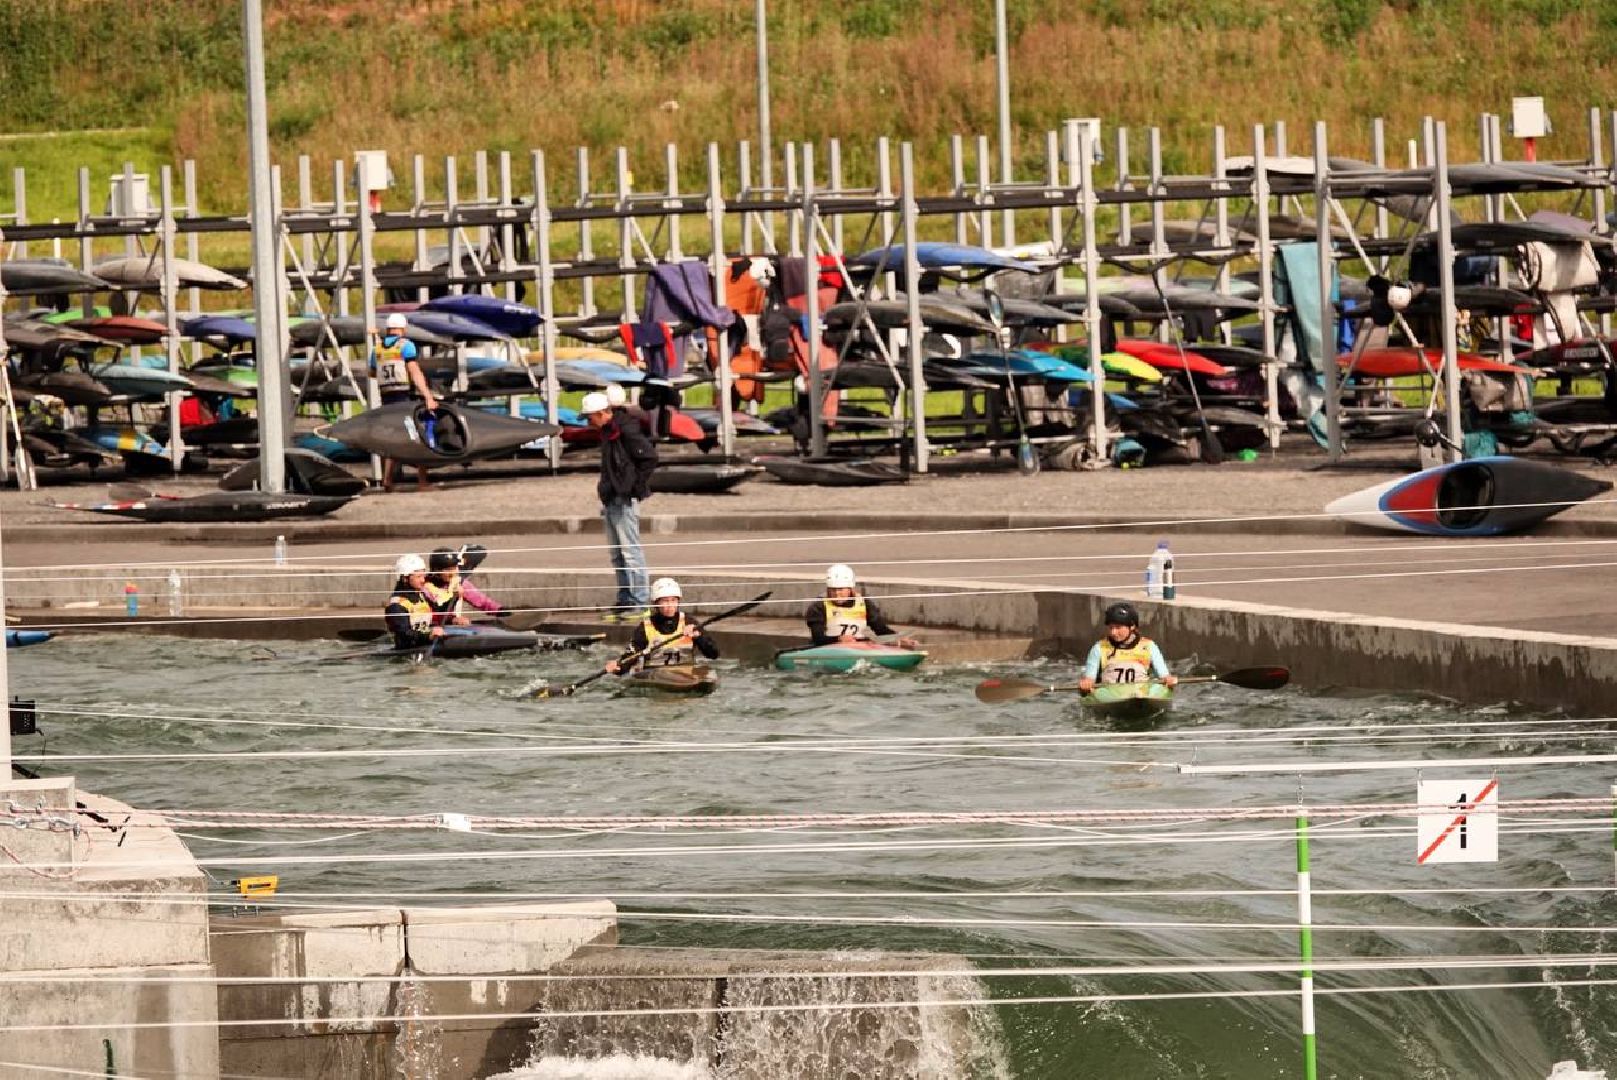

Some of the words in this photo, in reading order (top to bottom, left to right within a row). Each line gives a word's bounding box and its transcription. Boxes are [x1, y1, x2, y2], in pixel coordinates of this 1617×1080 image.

[383, 363, 396, 379] 57
[1114, 667, 1136, 684] 70
[1447, 793, 1467, 849] 1
